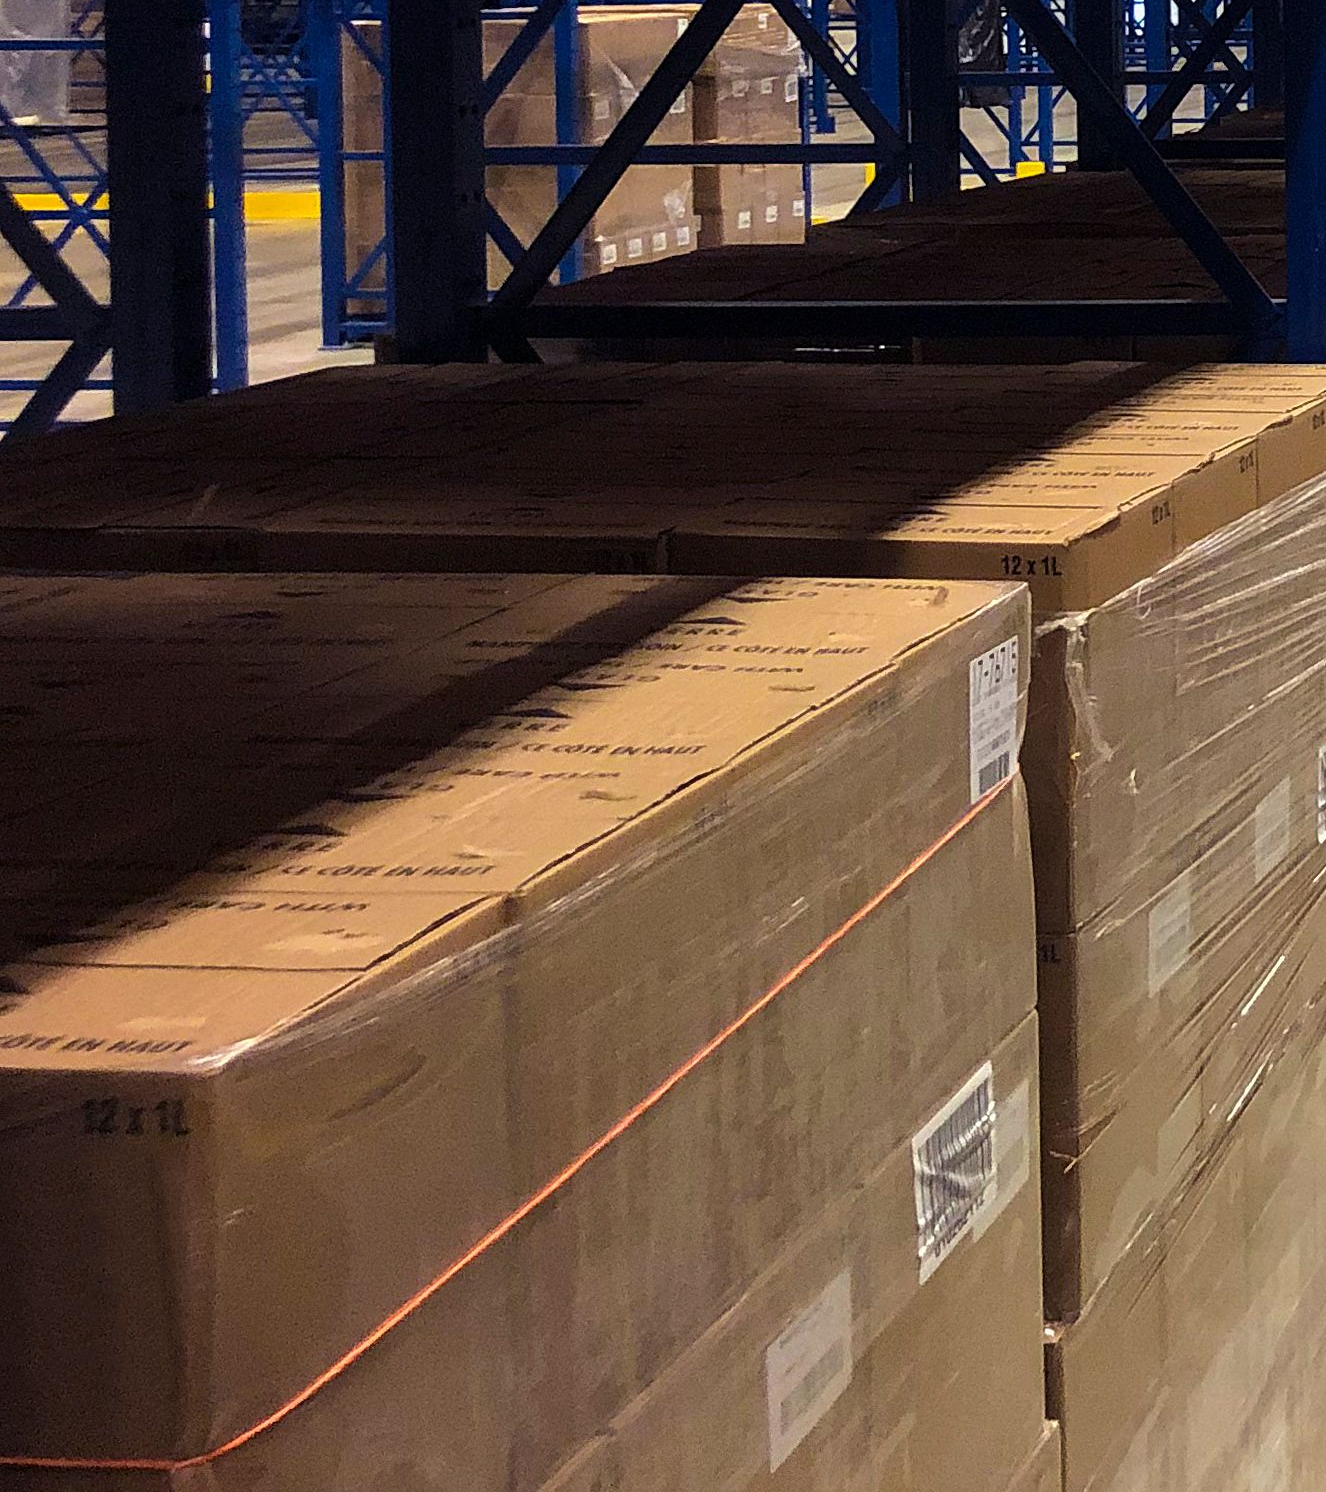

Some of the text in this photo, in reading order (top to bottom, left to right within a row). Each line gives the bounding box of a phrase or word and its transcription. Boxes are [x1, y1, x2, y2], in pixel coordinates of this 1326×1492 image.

[1000, 554, 1063, 577] 12 x 1L
[422, 864, 496, 878] HAUT
